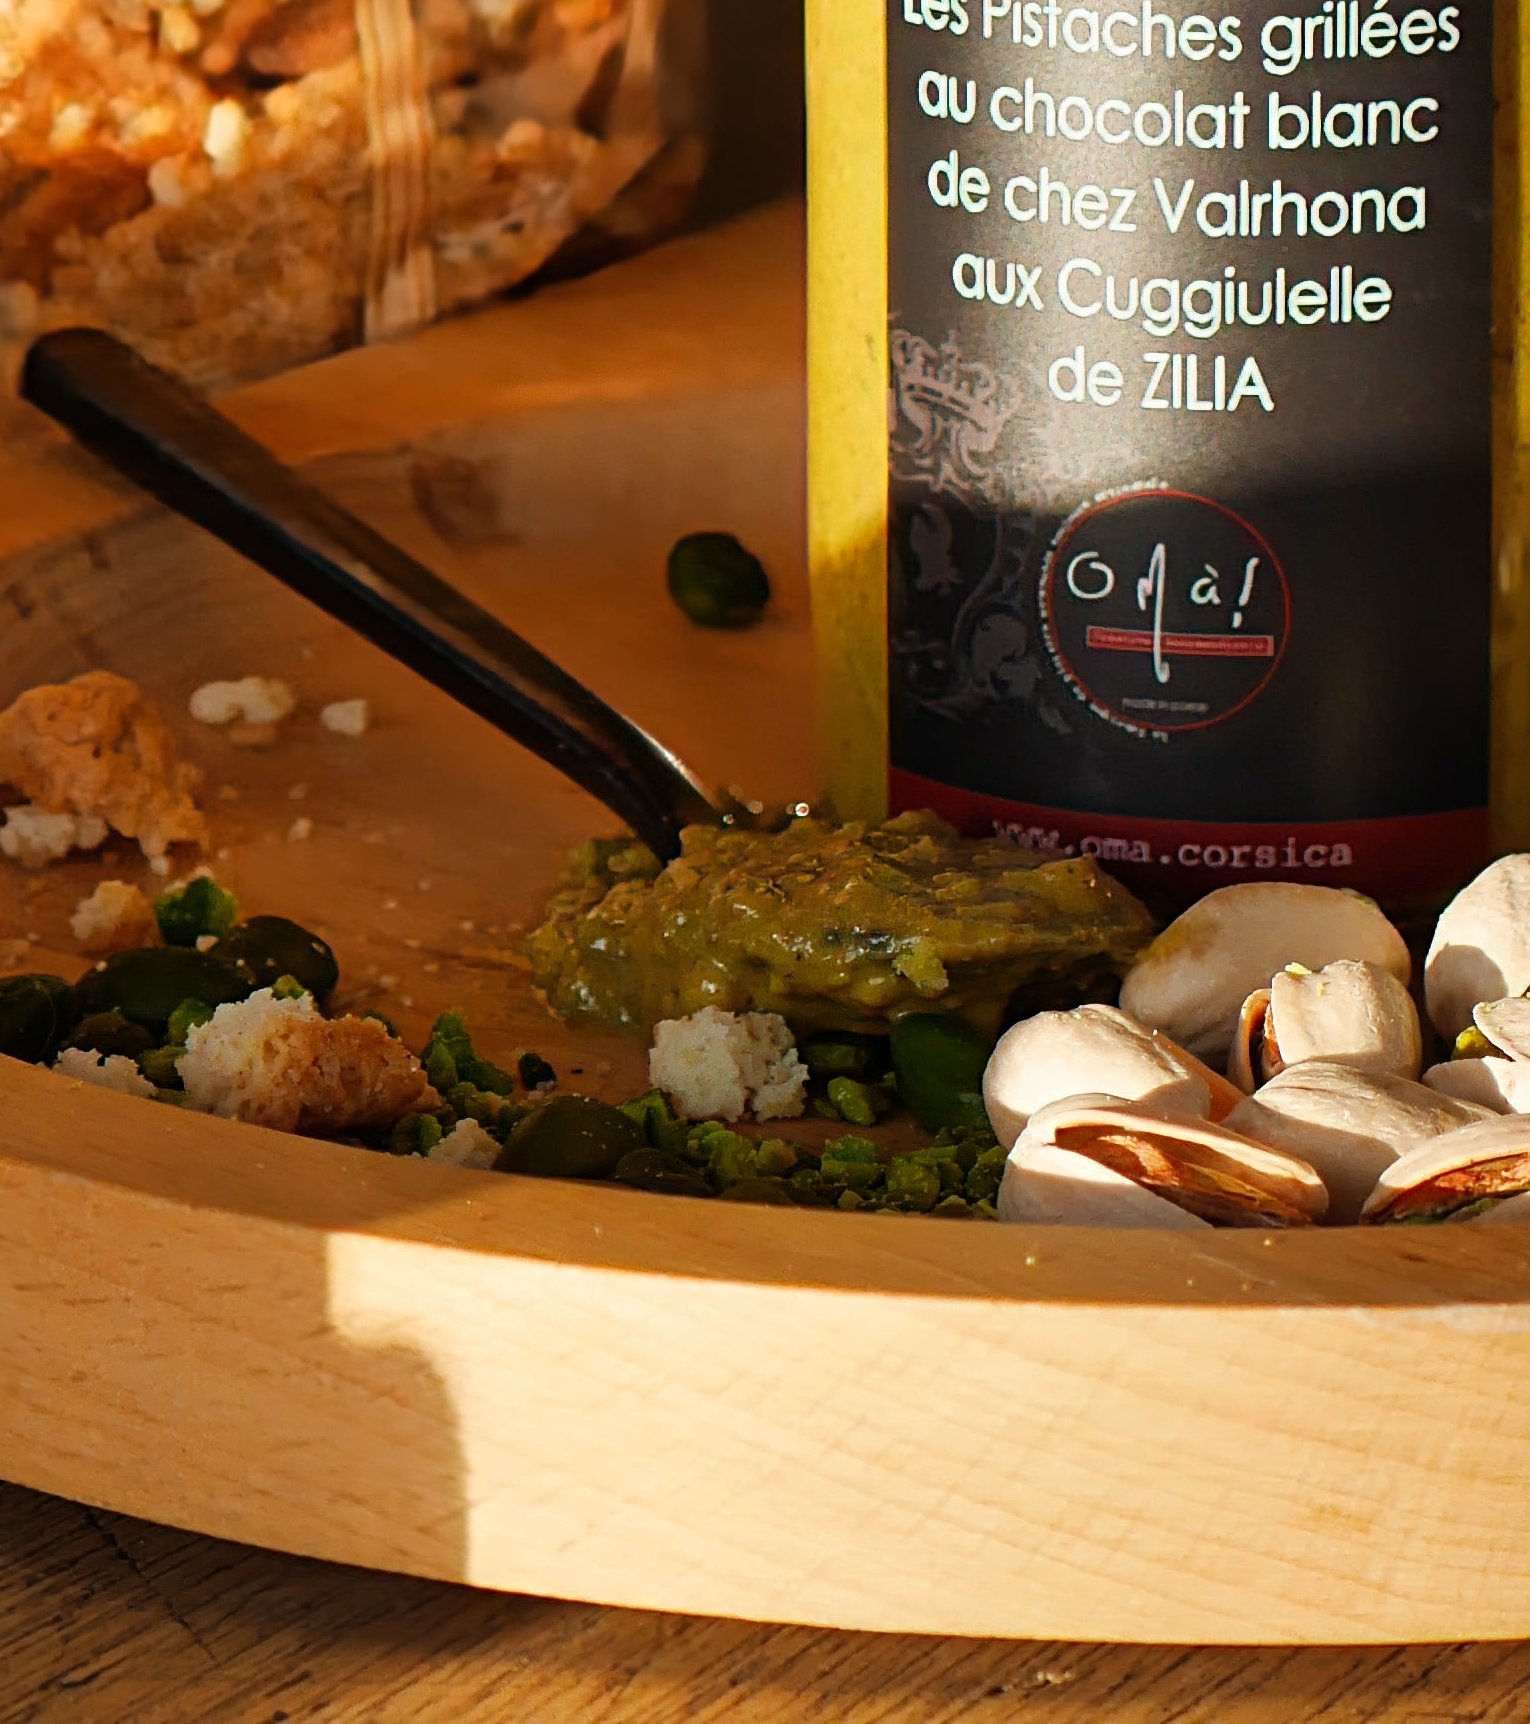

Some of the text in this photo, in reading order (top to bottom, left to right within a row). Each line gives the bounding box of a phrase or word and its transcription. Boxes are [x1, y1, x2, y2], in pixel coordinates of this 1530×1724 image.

[917, 69, 1440, 150] au chocolat blanc
[927, 150, 1428, 237] de chez Valrhona
[951, 251, 1393, 339] aux Cuggiulelle
[1047, 345, 1276, 413] de ZILIA
[991, 818, 1354, 869] www.oma.corsica
